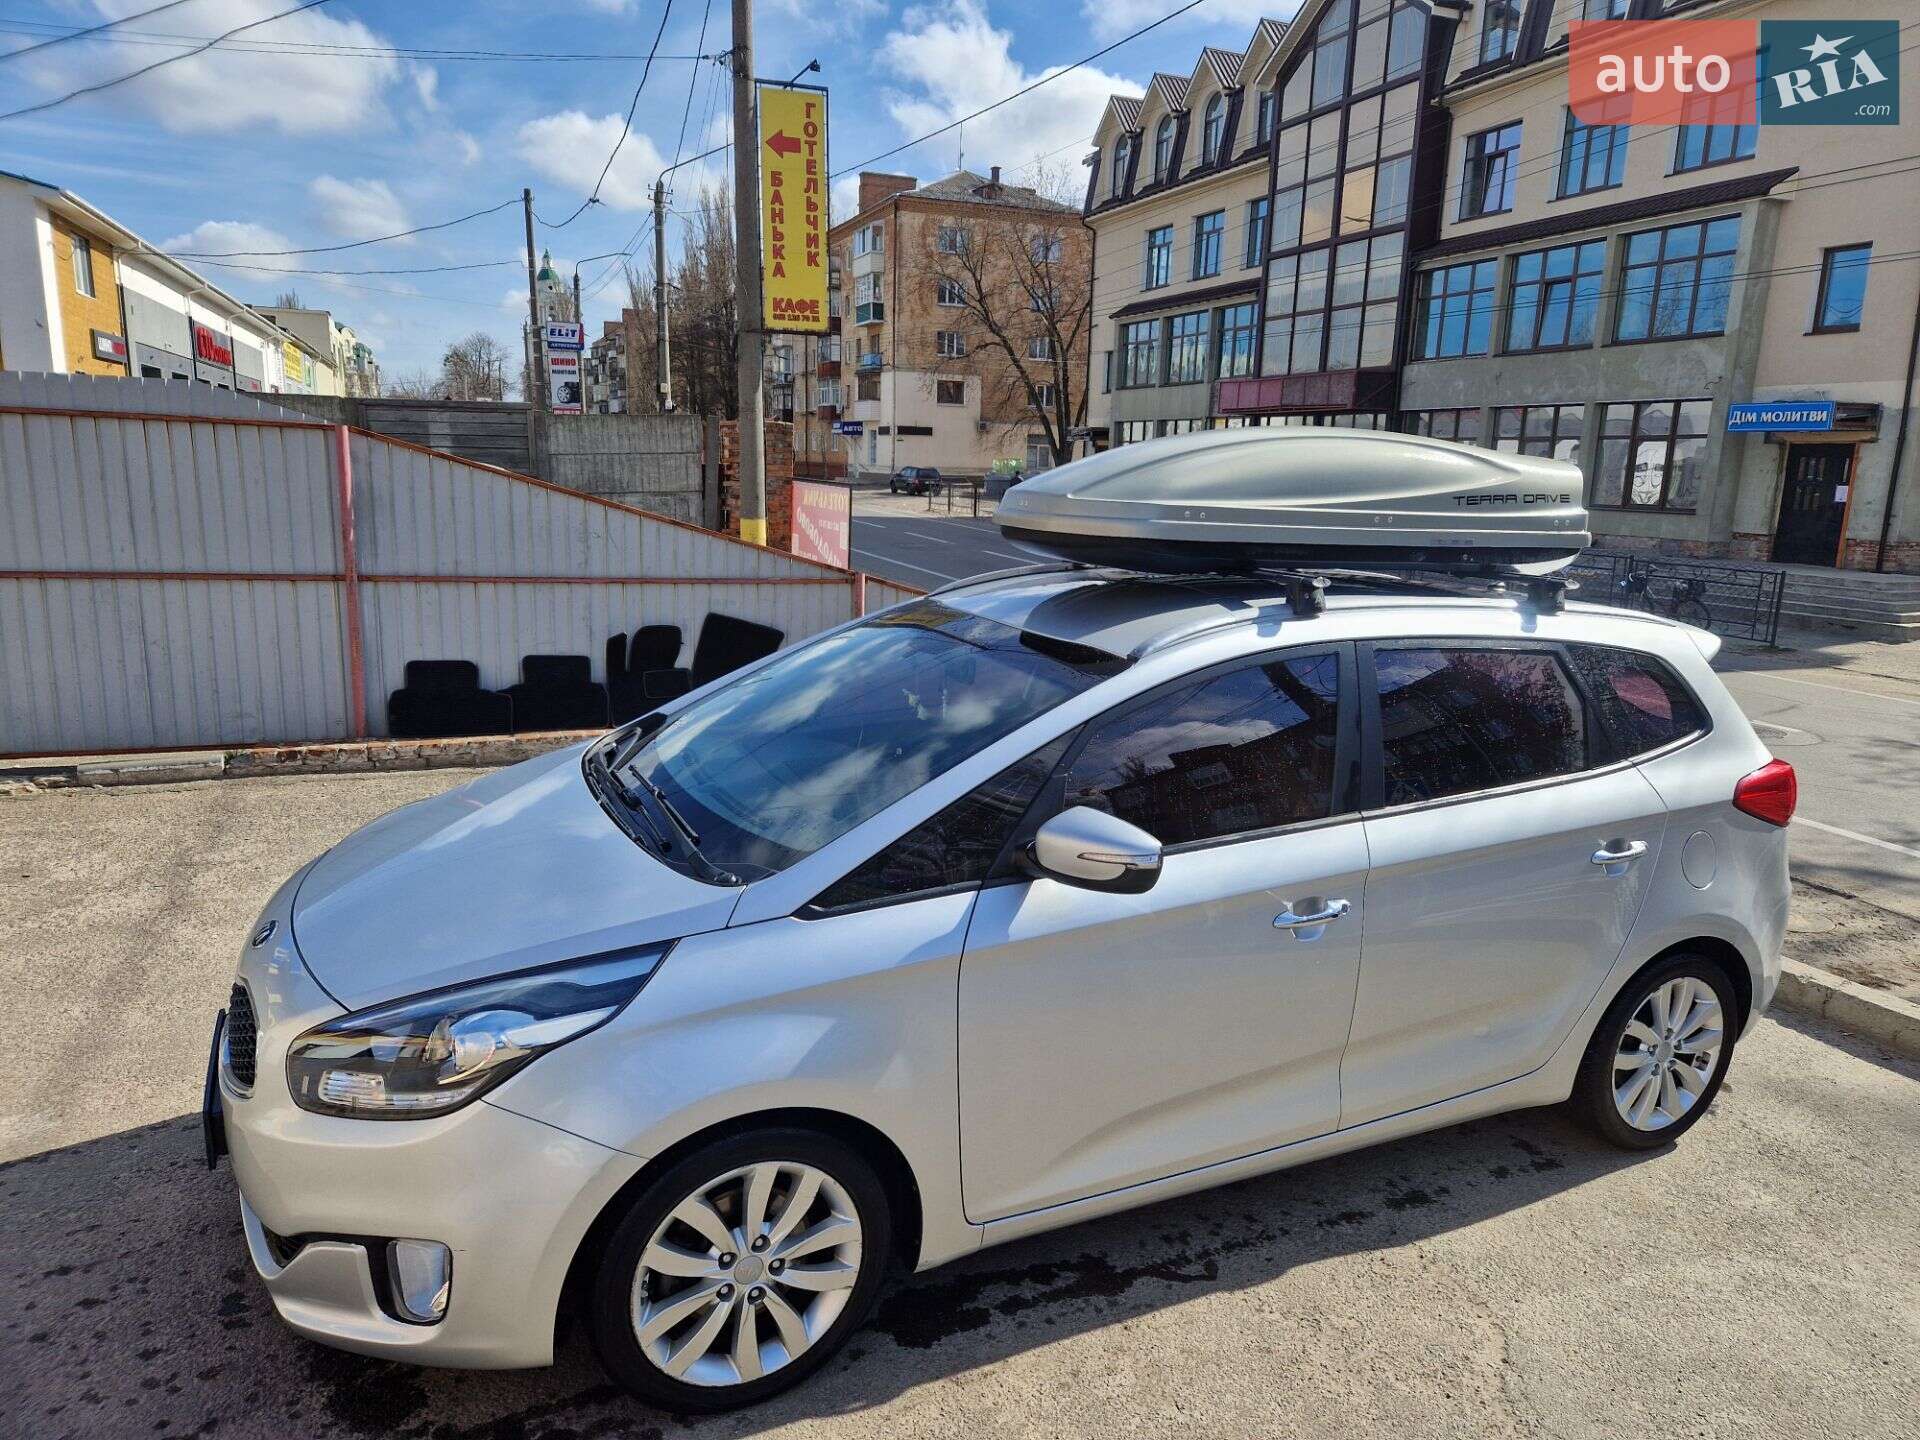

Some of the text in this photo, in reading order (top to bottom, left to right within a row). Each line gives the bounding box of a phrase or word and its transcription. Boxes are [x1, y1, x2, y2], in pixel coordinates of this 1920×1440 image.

[803, 102, 820, 268] ГОТЕЛЬЧИК
[771, 171, 785, 278] БАНЬКА
[772, 297, 820, 314] КАФЕ
[1760, 410, 1827, 423] МОЛИТВИ
[1452, 493, 1571, 507] TERRA DRIVE
